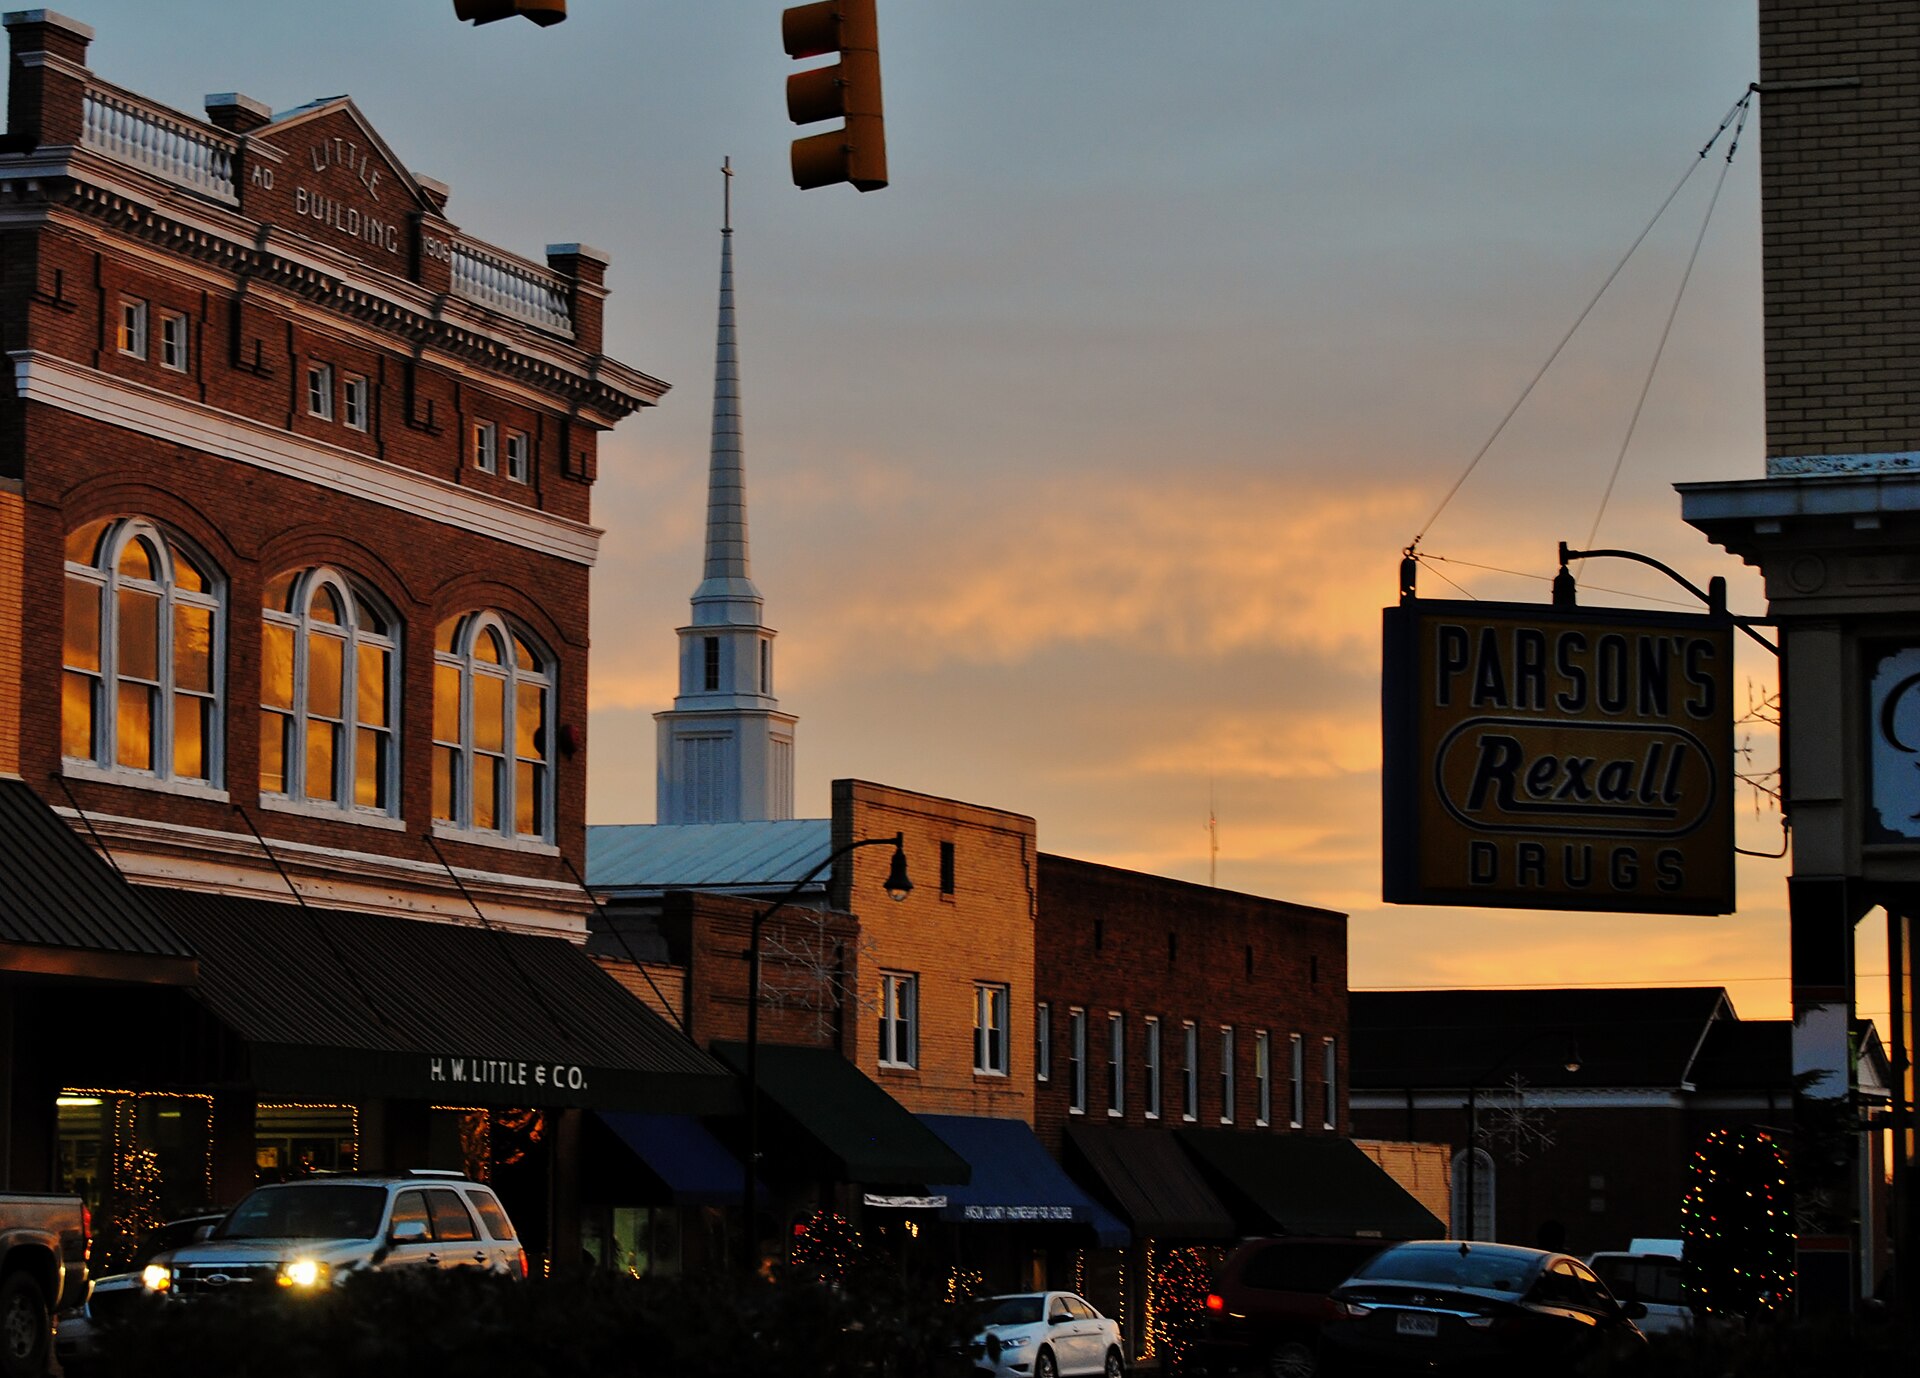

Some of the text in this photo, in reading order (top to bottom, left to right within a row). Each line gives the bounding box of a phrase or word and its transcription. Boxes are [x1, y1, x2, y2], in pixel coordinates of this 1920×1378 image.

[252, 164, 274, 190] AD
[311, 138, 381, 202] LITTLE
[296, 186, 399, 255] BUILDING
[1436, 624, 1715, 720] PARSON'S
[1465, 734, 1687, 818] Rexall
[1469, 840, 1684, 893] DRUGS
[472, 1059, 527, 1086] LITTLE
[534, 1064, 546, 1087] &
[552, 1065, 588, 1090] CO.
